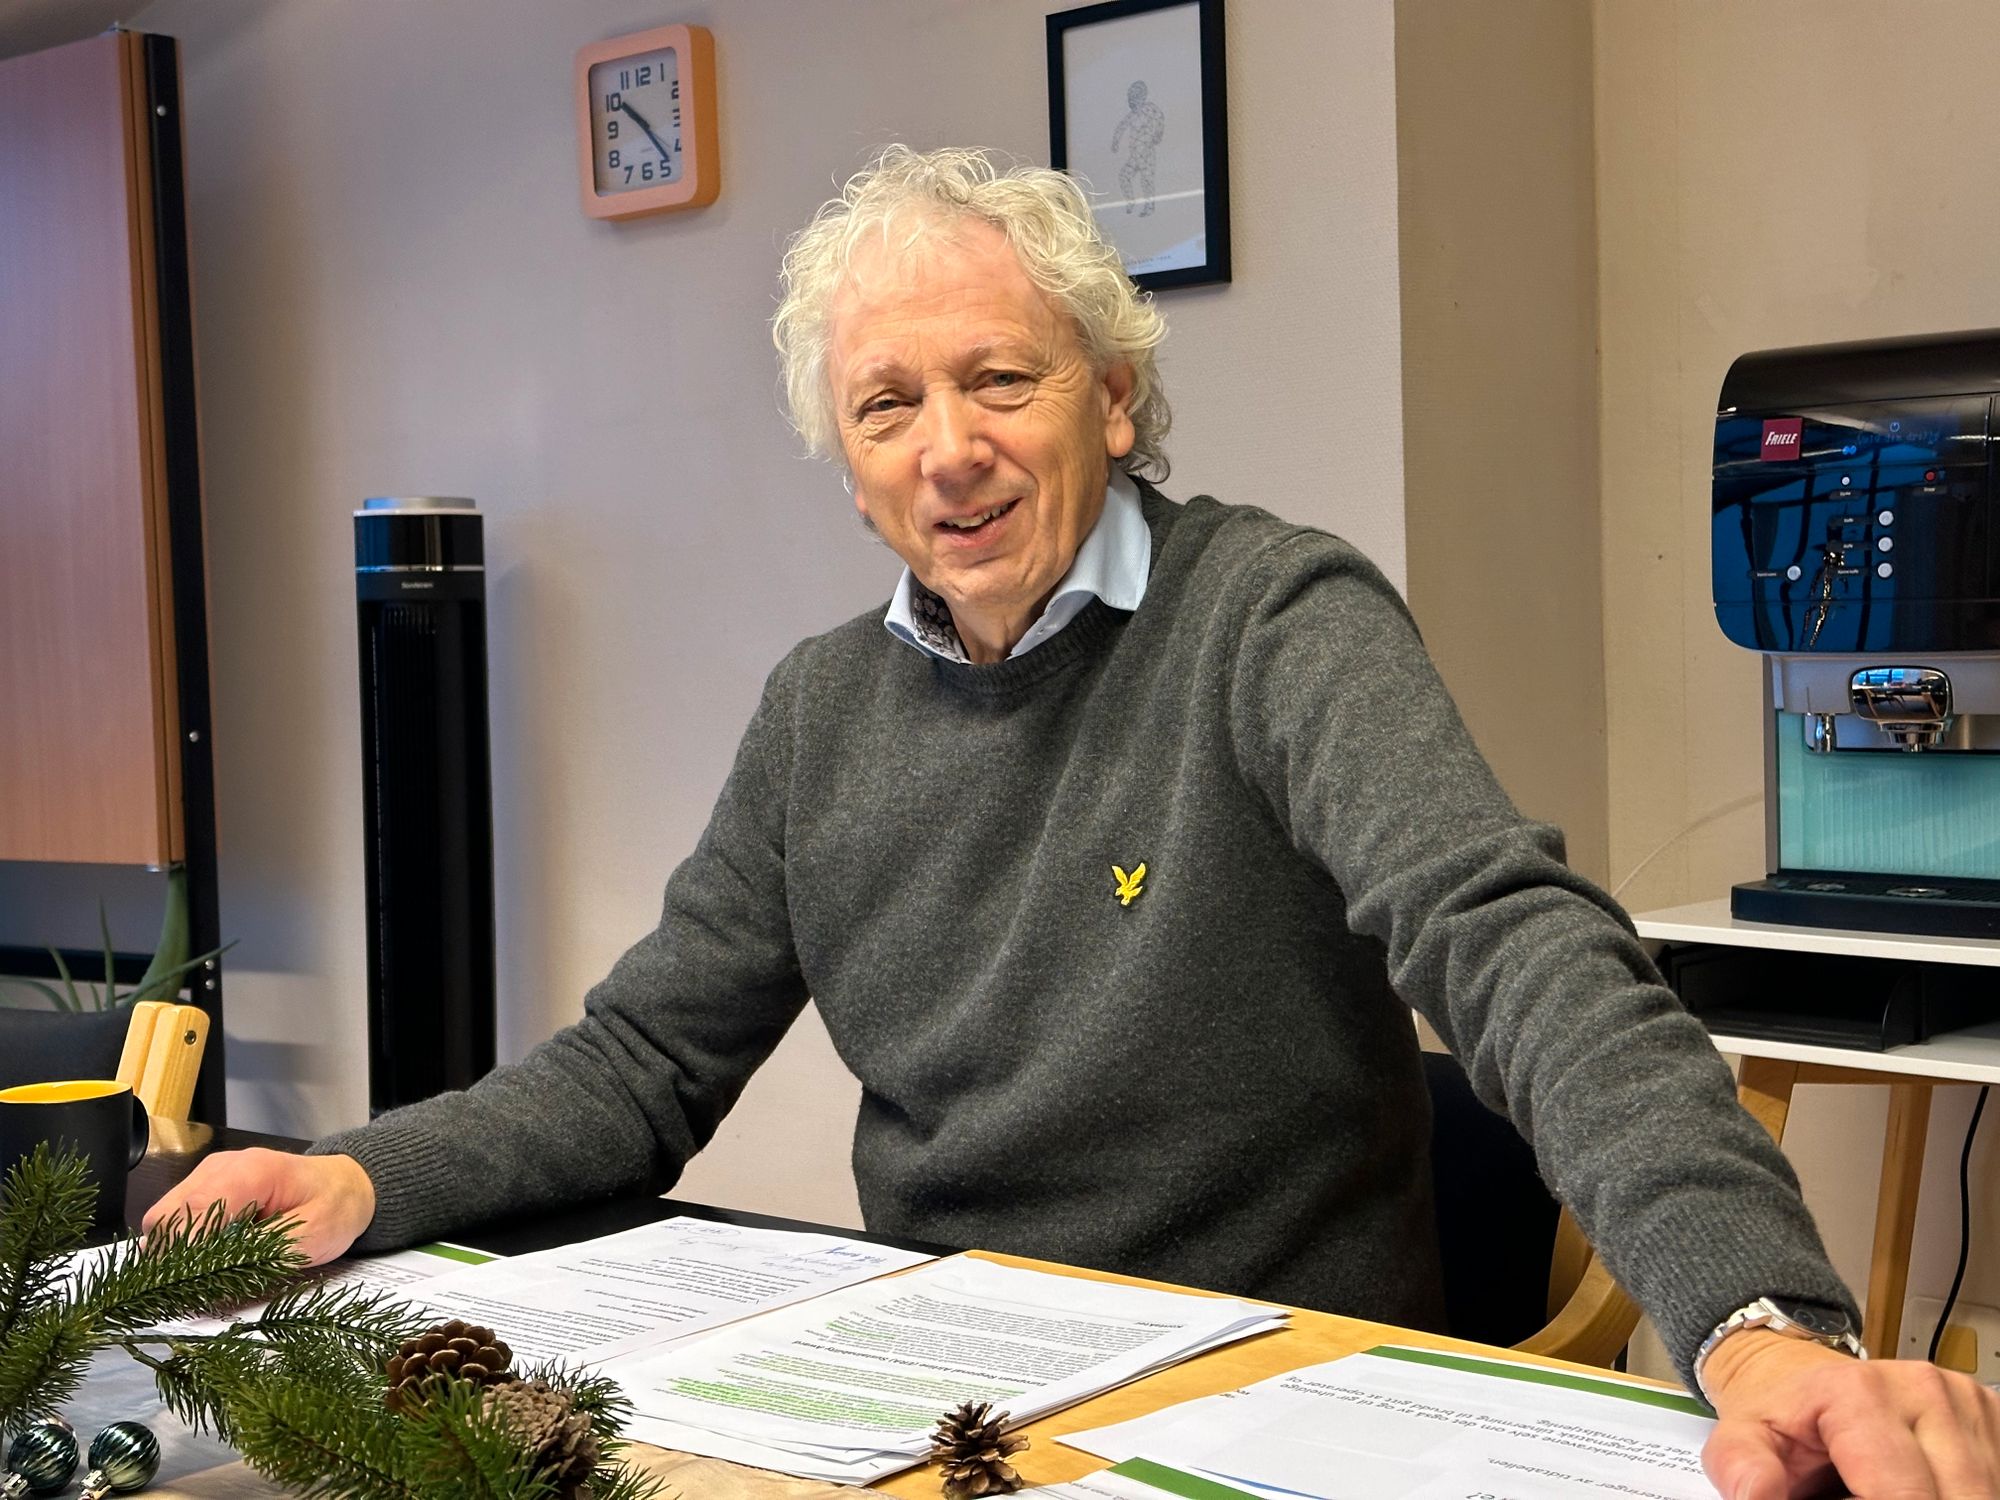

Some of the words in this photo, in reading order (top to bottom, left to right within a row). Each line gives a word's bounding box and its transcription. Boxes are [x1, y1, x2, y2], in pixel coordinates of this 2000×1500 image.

[620, 71, 630, 91] 11
[635, 67, 651, 87] 12
[606, 92, 622, 112] 10
[608, 121, 619, 140] 9
[609, 150, 620, 168] 8
[624, 165, 634, 184] 7
[641, 162, 654, 181] 6
[660, 159, 672, 178] 5
[1765, 431, 1798, 446] FRIELE
[792, 1340, 825, 1350] Award
[825, 1346, 888, 1361] Sustainability
[919, 1363, 951, 1371] Airline
[950, 1369, 997, 1380] Regional
[998, 1376, 1047, 1386] European
[1279, 1382, 1336, 1397] uheldige
[1376, 1402, 1396, 1411] og
[1409, 1403, 1456, 1417] brudd
[1415, 1411, 1450, 1422] også
[1452, 1418, 1478, 1428] det
[1476, 1415, 1555, 1434] tilnærming
[1480, 1424, 1506, 1433] om
[1508, 1430, 1540, 1439] selv
[1558, 1431, 1645, 1453] pragmatisk
[1542, 1436, 1657, 1463] anbudskravene
[1646, 1450, 1666, 1458] en
[1664, 1446, 1692, 1456] det
[1657, 1461, 1678, 1469] til
[1669, 1456, 1698, 1467] har
